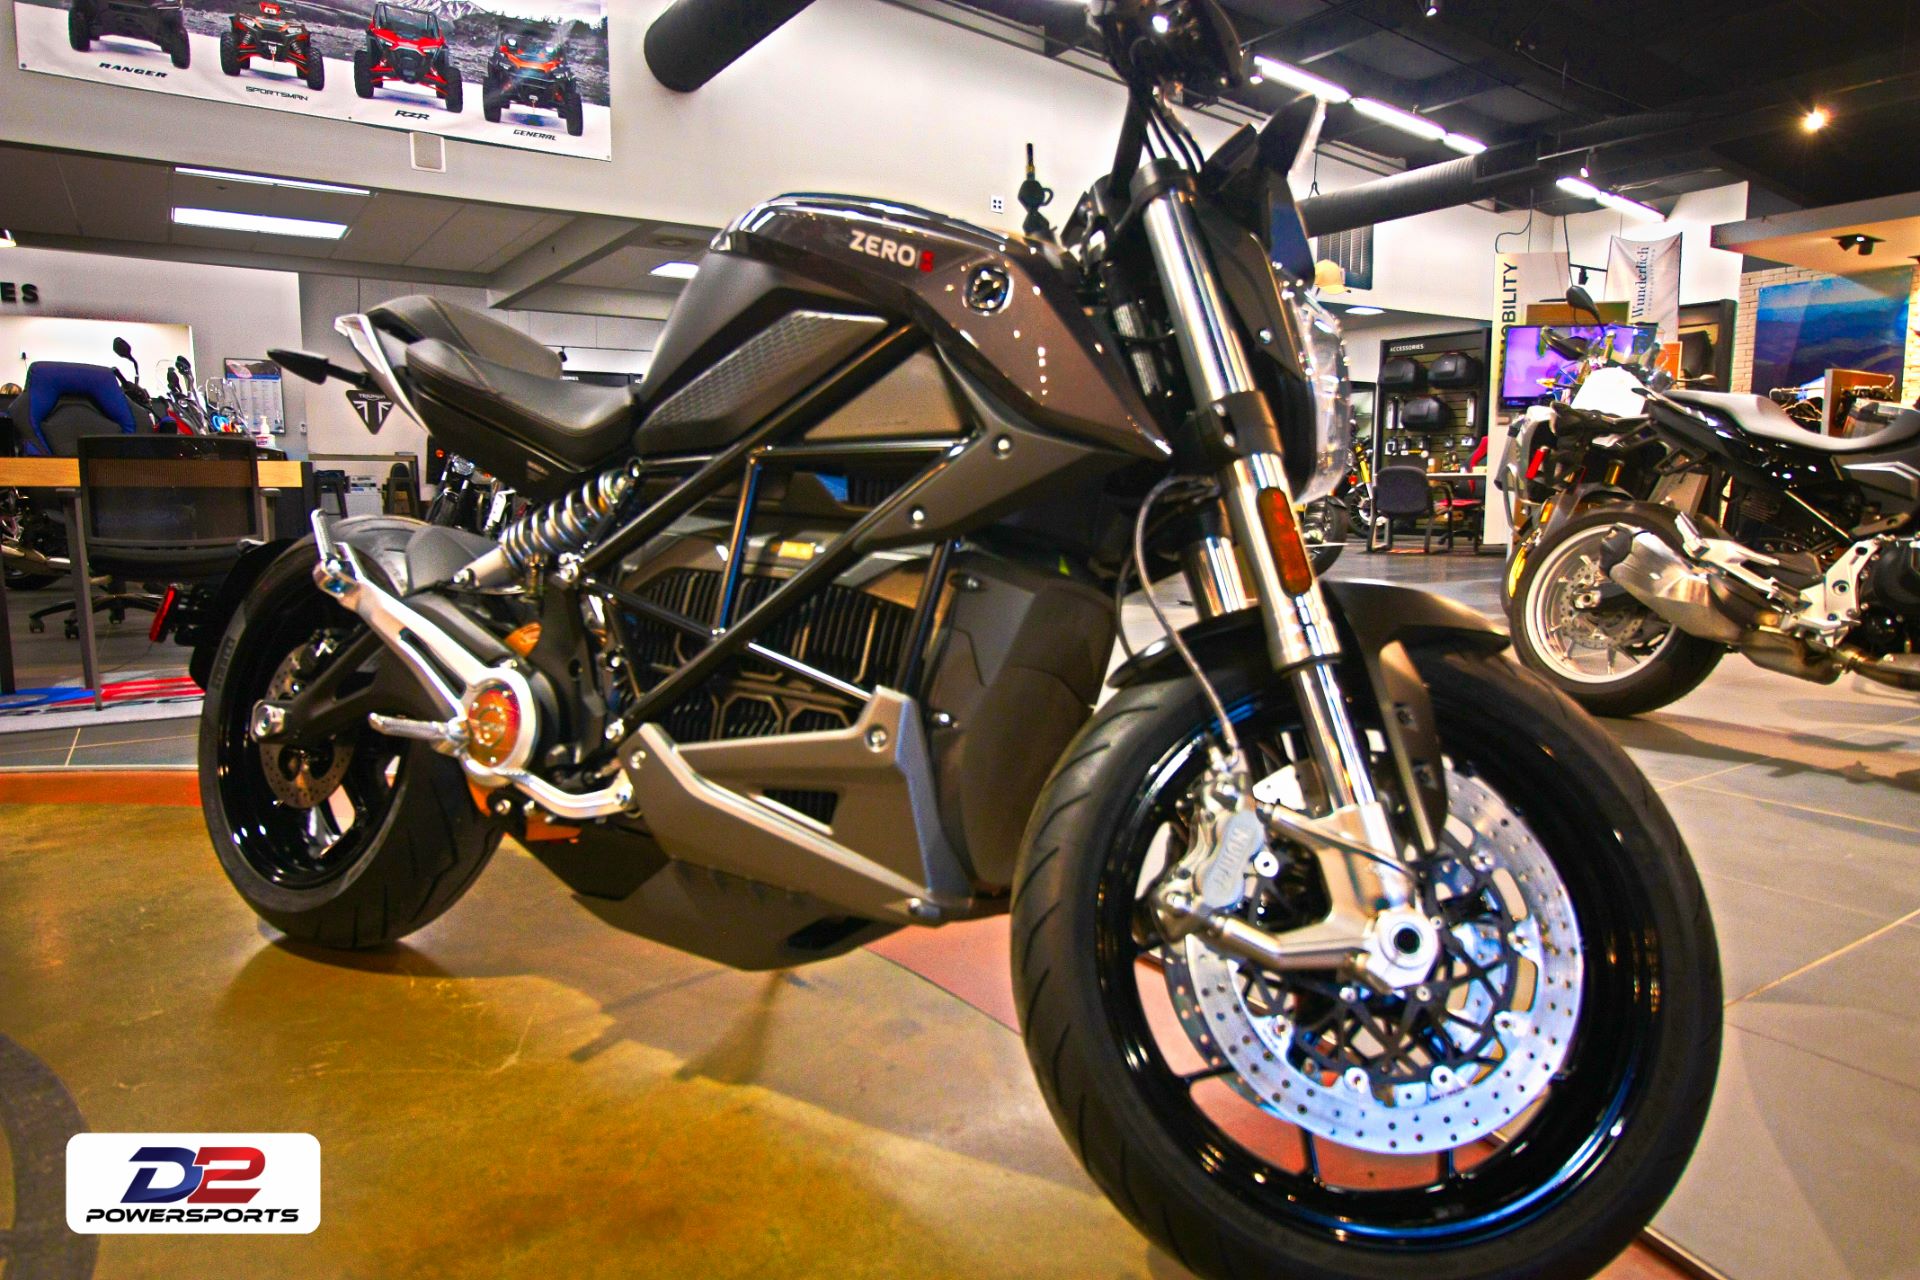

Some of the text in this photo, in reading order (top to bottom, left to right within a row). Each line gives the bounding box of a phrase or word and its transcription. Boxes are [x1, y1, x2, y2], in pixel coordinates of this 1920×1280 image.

[99, 62, 168, 78] RANGER
[245, 86, 309, 101] SPORTSMAN
[394, 110, 430, 121] RZR
[513, 129, 557, 141] GENERAL
[849, 229, 917, 268] ZERO
[1631, 246, 1649, 318] Wunderlich
[0, 282, 39, 303] ES
[1501, 263, 1518, 338] BILITY
[1389, 344, 1424, 352] ACCESSORIES
